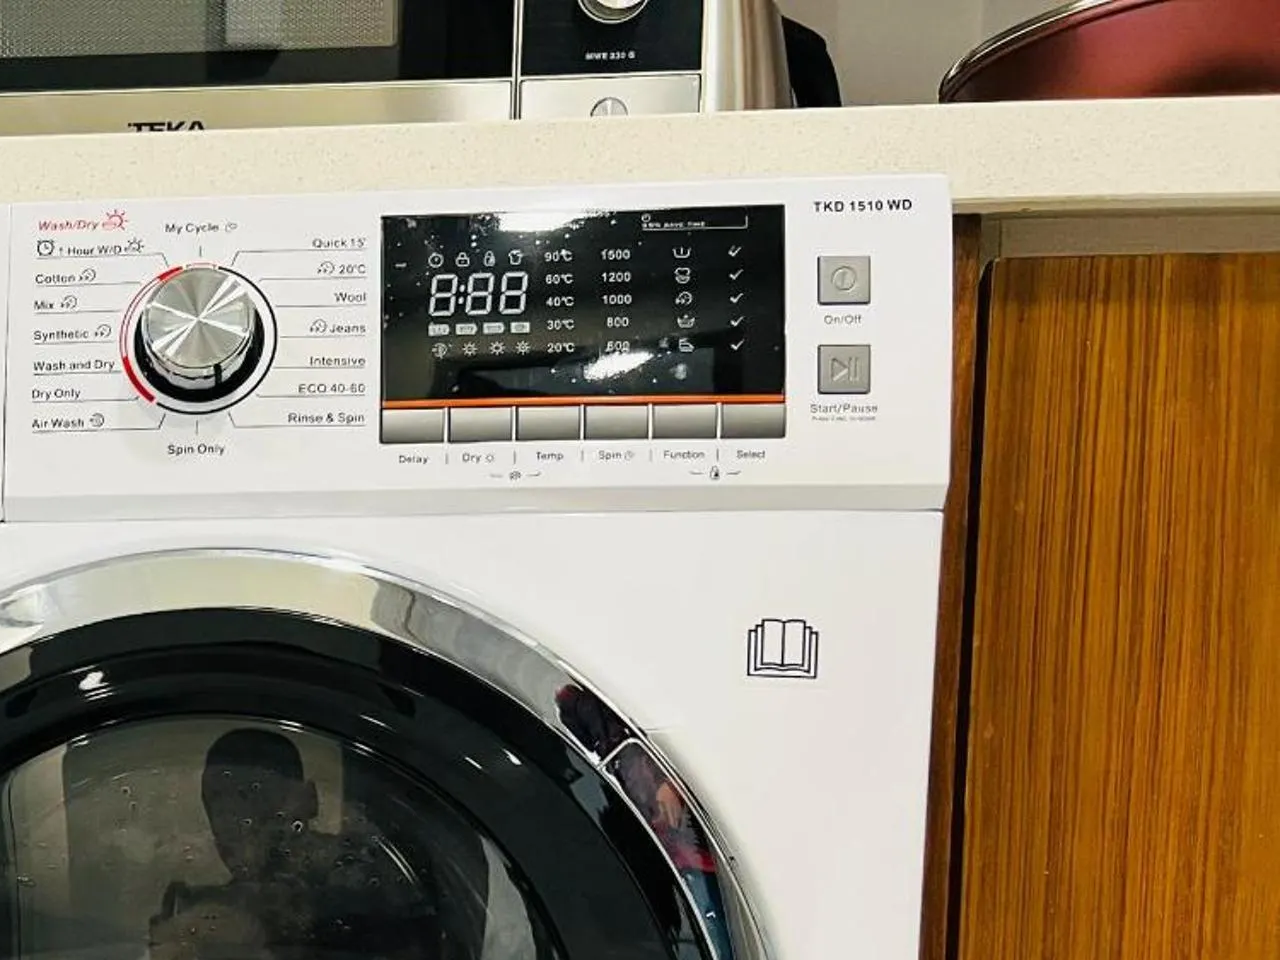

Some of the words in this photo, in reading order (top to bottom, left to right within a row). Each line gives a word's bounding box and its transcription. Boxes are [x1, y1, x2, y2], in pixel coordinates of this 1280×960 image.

[814, 200, 845, 212] TKD
[850, 199, 883, 212] 1510
[887, 198, 912, 211] WD
[38, 219, 98, 231] Wash/Dry
[165, 223, 183, 235] My
[185, 222, 220, 235] Cycle
[312, 238, 348, 248] Quick
[67, 246, 95, 256] Hour
[600, 249, 631, 260] 1500
[35, 273, 76, 284] Cotton
[601, 271, 631, 283] 1200
[334, 292, 367, 302] Wool
[601, 294, 633, 305] 1000
[34, 300, 54, 310] Mix
[606, 317, 629, 328] 800
[823, 314, 862, 325] On/Off
[329, 324, 366, 334] Jeans
[33, 330, 89, 343] Synthetic
[33, 361, 66, 371] Wash
[69, 360, 91, 370] and
[94, 359, 115, 372] Dry
[310, 356, 366, 366] Intensive
[298, 383, 327, 393] ECO
[330, 383, 366, 393] 40-60
[32, 388, 51, 401] Dry
[54, 388, 81, 400] Only
[810, 403, 878, 415] Start/Pause
[32, 419, 48, 429] Air
[51, 418, 84, 428] Wash
[287, 412, 324, 423] Rinse
[325, 412, 334, 423] &
[338, 412, 365, 424] Spin
[167, 444, 194, 456] Spin
[197, 443, 225, 456] Only
[663, 449, 706, 460] Function
[736, 449, 766, 460] Select
[398, 454, 428, 465] Delay
[462, 453, 482, 465] Dry
[598, 450, 622, 461] Spin
